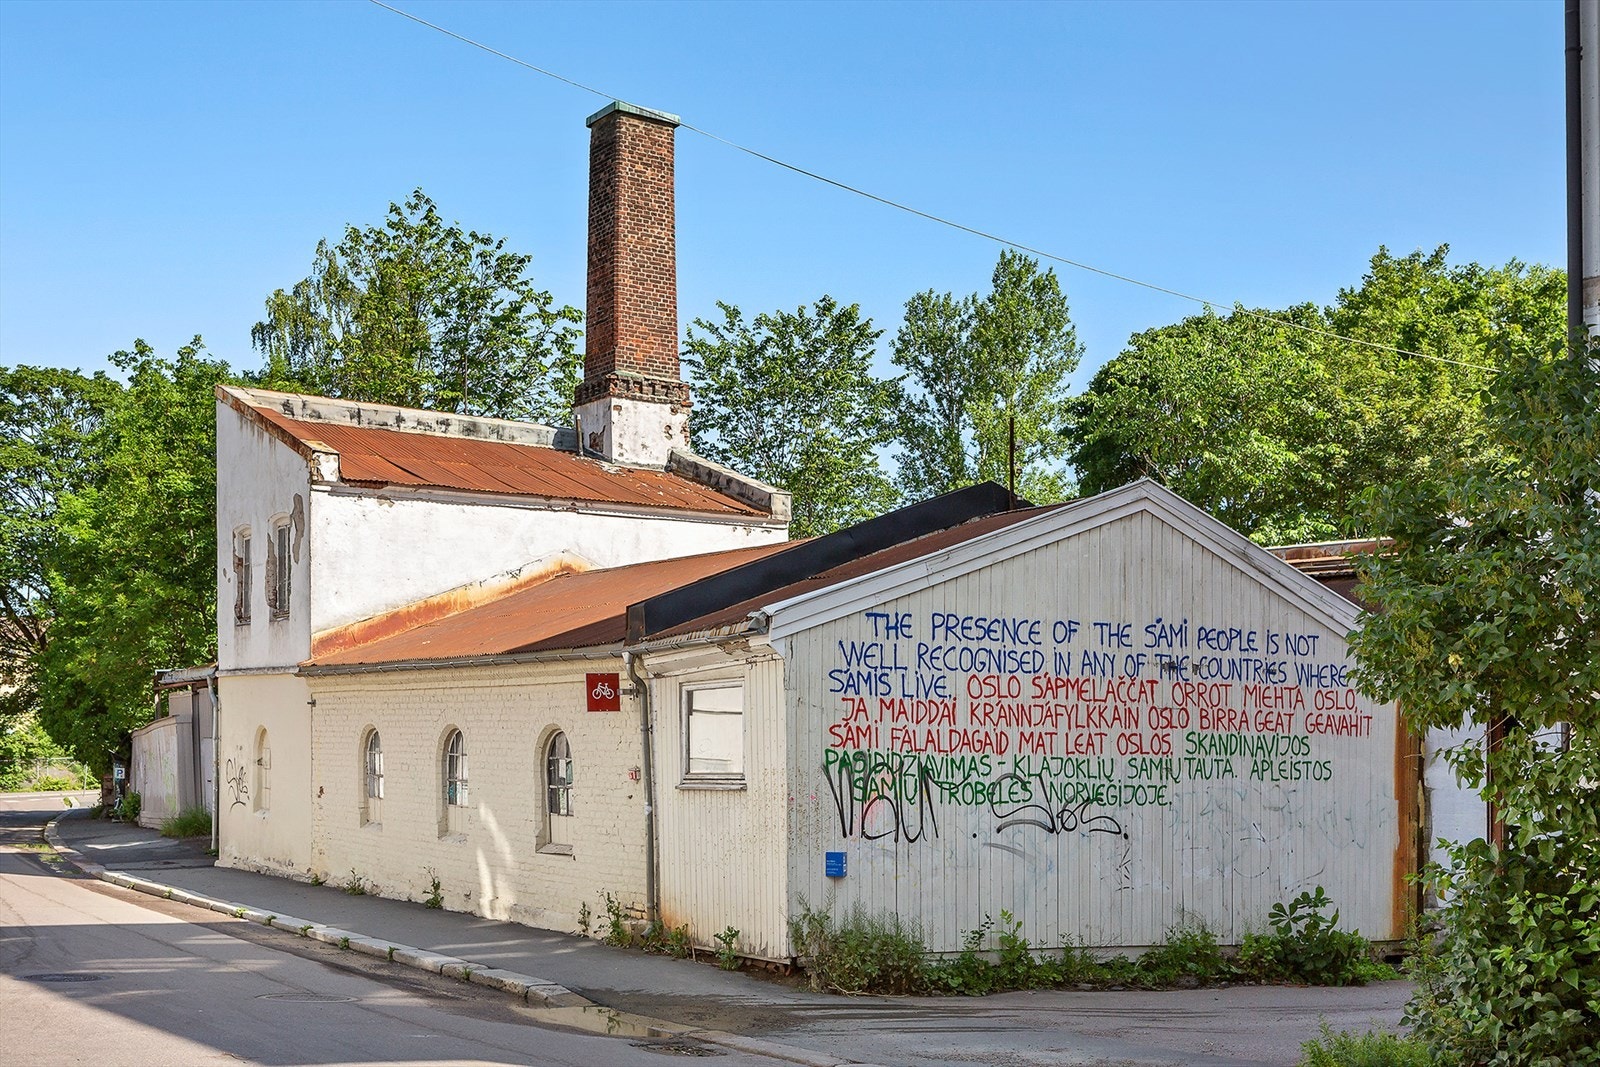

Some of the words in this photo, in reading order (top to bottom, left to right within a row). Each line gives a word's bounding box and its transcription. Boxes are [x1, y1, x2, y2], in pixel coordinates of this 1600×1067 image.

[865, 612, 913, 640] THE
[931, 613, 1042, 645] PRESENCE
[1053, 620, 1080, 644] OF
[1093, 622, 1133, 648] THE
[1197, 627, 1258, 652] PEOPLE
[1266, 629, 1279, 655] IS
[1286, 633, 1319, 657] NOT
[838, 640, 908, 671] WELL
[917, 642, 1045, 674] RECOGNISED
[1053, 646, 1071, 677] IN
[1081, 650, 1116, 678] ANY
[1124, 653, 1147, 677] OF
[1154, 653, 1190, 681] THE
[1199, 656, 1287, 685] COUNTRIES
[1294, 661, 1349, 688] WHERE
[901, 671, 953, 699] LIVE.
[967, 674, 1021, 699] OSLO
[1171, 682, 1232, 708] ORROT
[1314, 689, 1358, 712] OSLO,
[841, 697, 869, 722] JA
[1148, 707, 1190, 730] OSLO
[1200, 706, 1250, 732] BIRRA
[1254, 710, 1294, 733] GEAT
[1305, 710, 1373, 737] GEAVAHIT
[1019, 731, 1058, 755] MAT
[1065, 732, 1107, 755] LEAT
[1186, 731, 1311, 757] SKANDINAVIJOS
[1250, 756, 1332, 782] APLEISTOS
